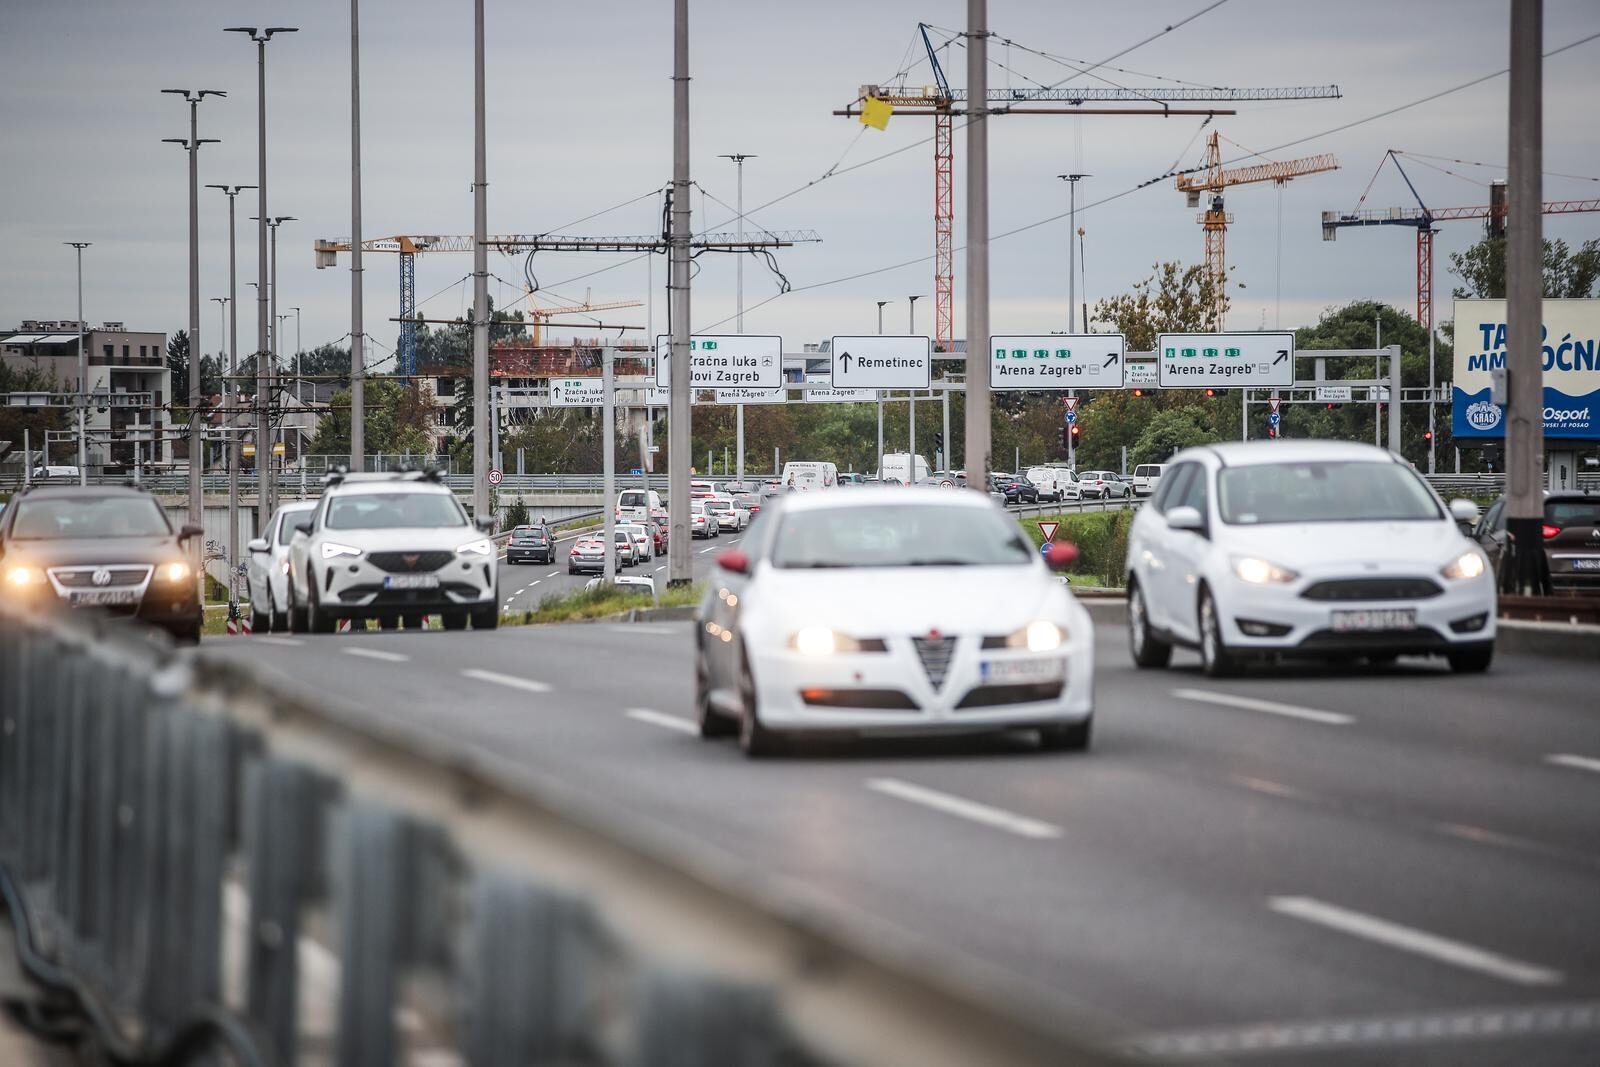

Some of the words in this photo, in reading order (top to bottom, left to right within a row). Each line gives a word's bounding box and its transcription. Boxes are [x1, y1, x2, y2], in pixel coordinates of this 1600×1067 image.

[732, 356, 757, 366] luka
[858, 356, 923, 368] Remetinec
[716, 370, 760, 384] Zagreb
[491, 473, 500, 482] 50
